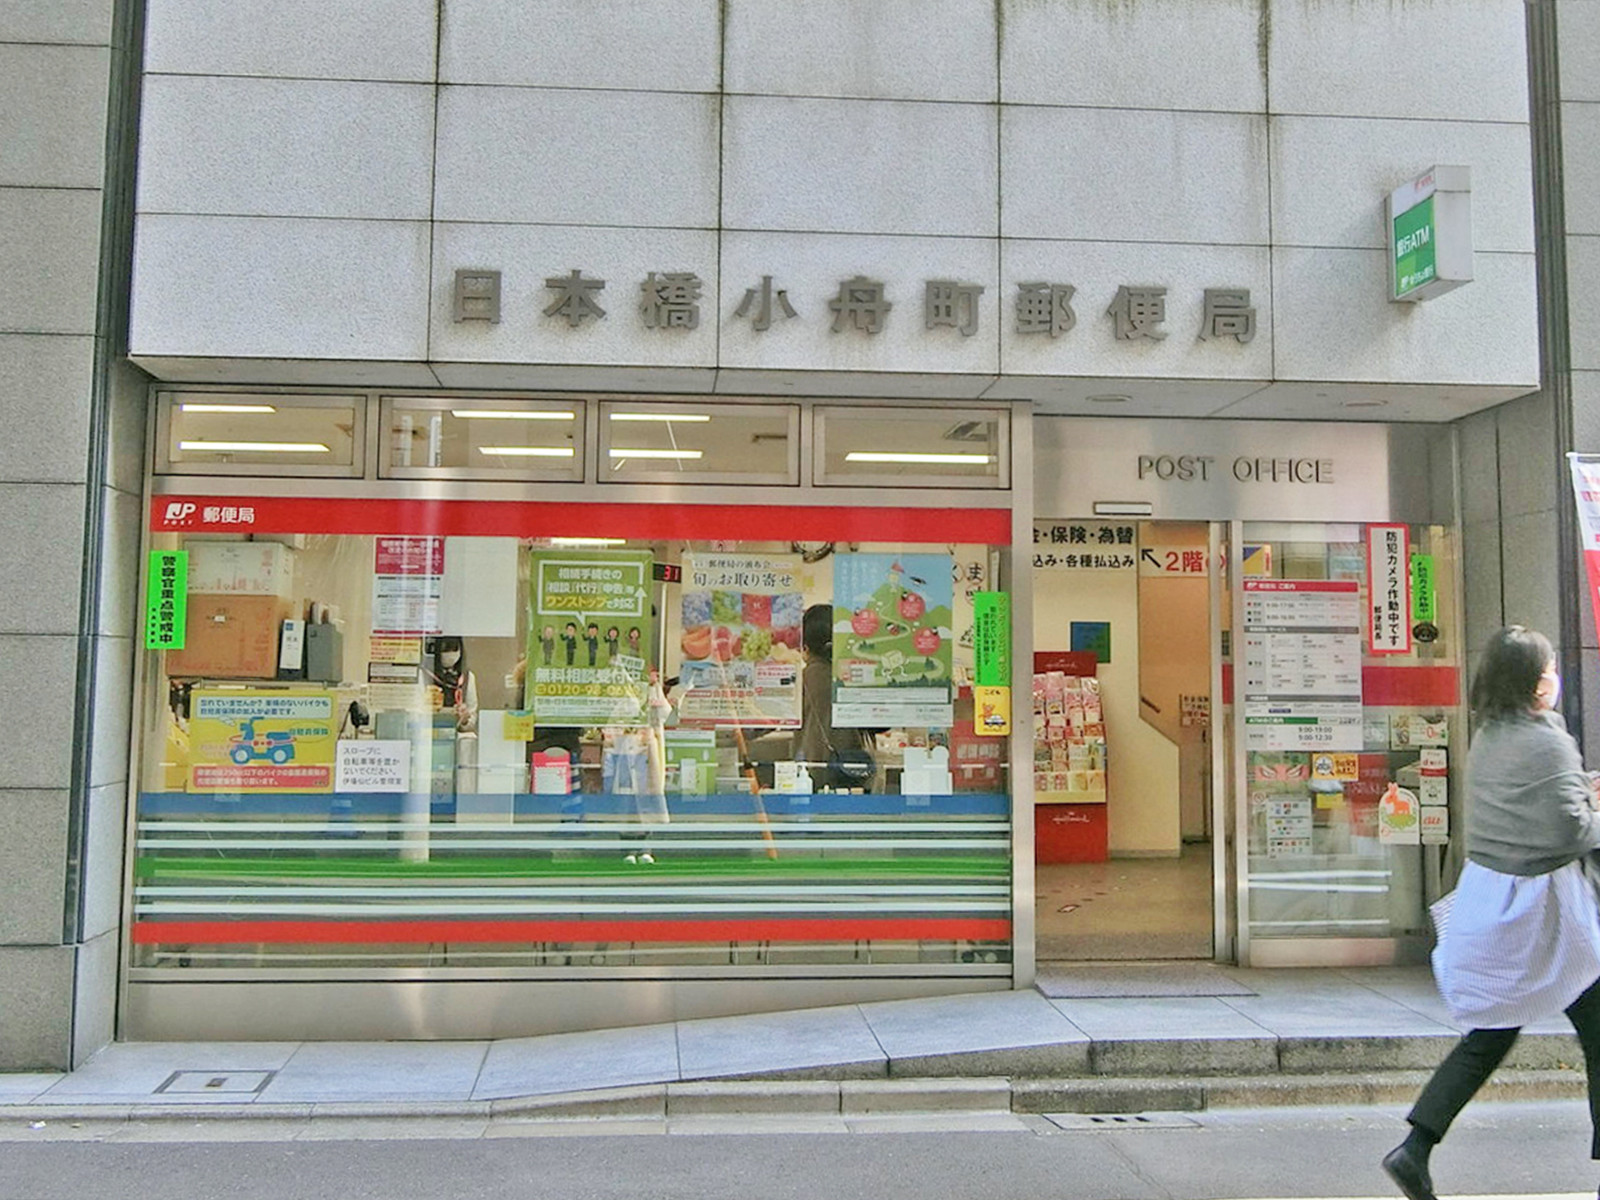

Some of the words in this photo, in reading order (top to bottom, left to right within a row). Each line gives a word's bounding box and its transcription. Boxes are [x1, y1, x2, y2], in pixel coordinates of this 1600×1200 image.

[453, 268, 1259, 343] 日本橋小舟町郵便局
[1137, 455, 1214, 481] POST
[1232, 456, 1335, 484] OFFICE
[202, 506, 255, 524] 郵便局
[693, 572, 793, 588] 旬のお取り寄せ
[1386, 531, 1400, 646] 防犯カメラ作動中です
[343, 747, 382, 755] スロープに
